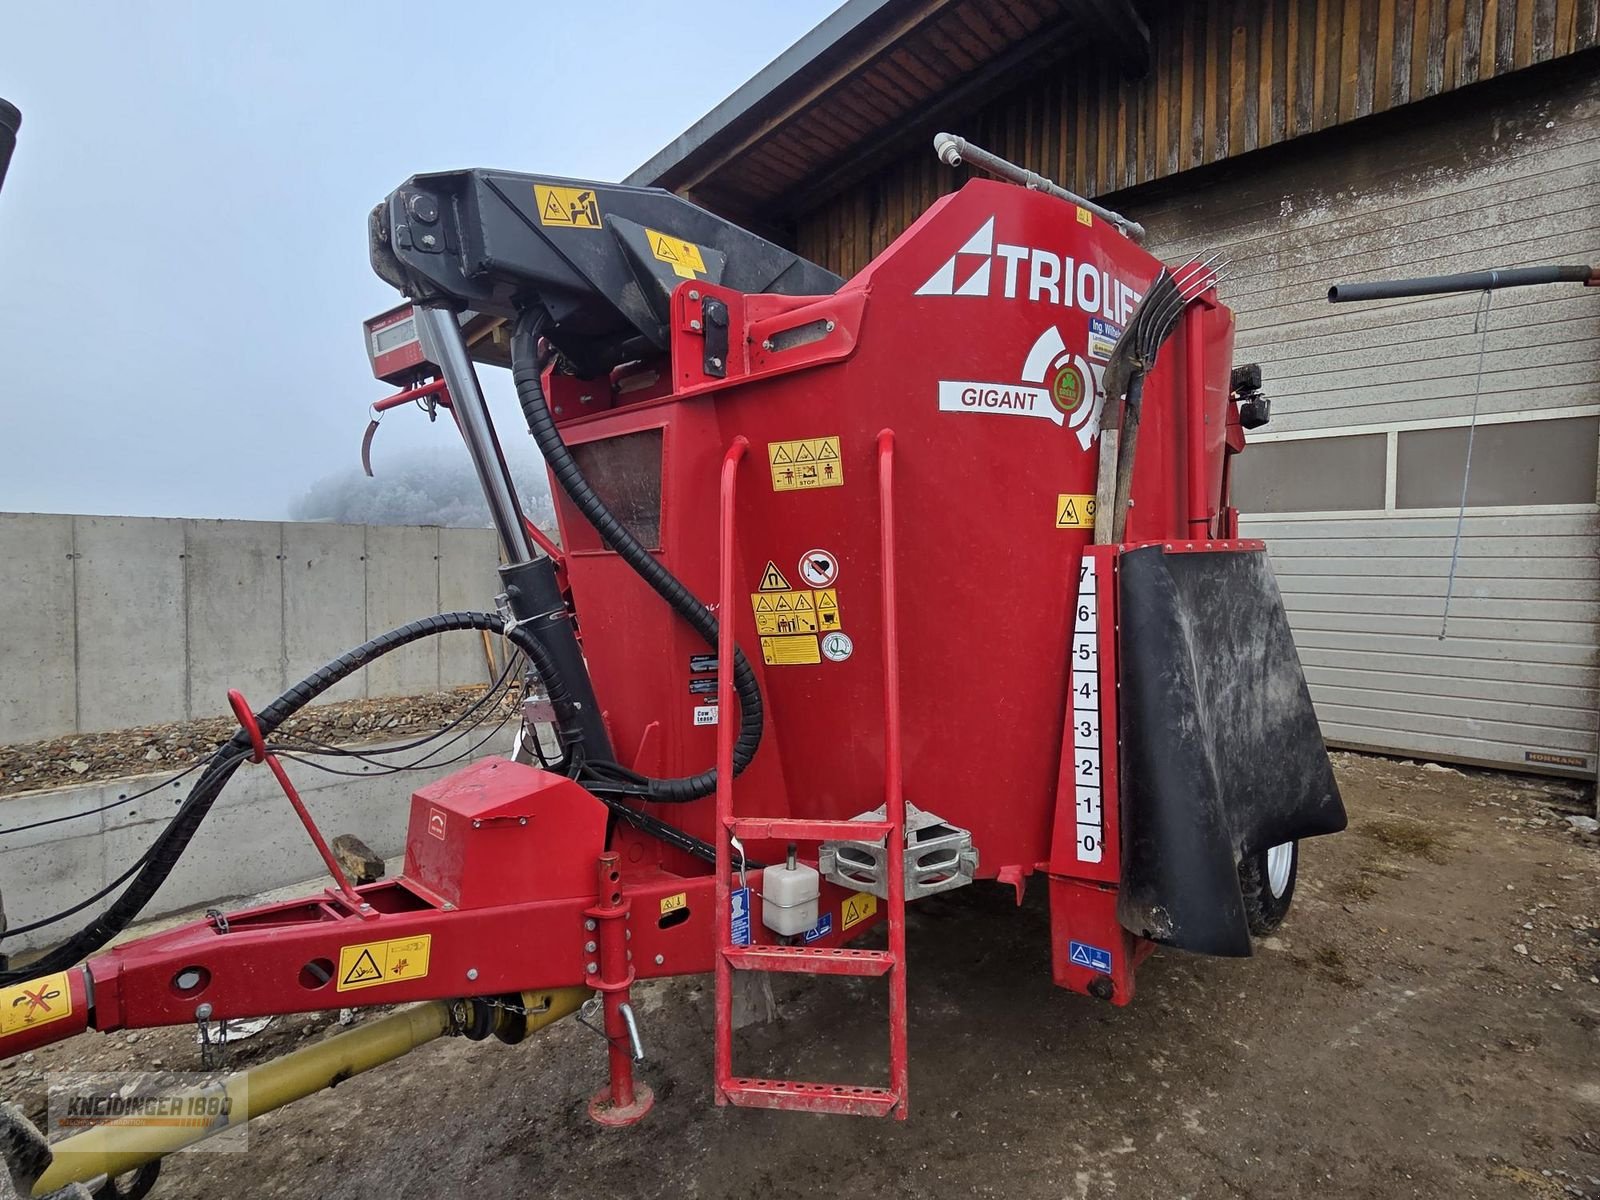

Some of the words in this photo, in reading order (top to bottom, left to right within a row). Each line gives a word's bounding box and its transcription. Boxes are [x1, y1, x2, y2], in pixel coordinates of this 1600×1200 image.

[997, 244, 1142, 327] TRIOLIF
[961, 388, 1038, 411] GIGANT
[1080, 566, 1089, 583] 7
[1078, 605, 1090, 622] 6
[1079, 643, 1090, 660] 5
[1079, 682, 1091, 699] 4
[1080, 721, 1092, 737] 3
[1081, 759, 1093, 776] 2
[1083, 797, 1092, 813] 1
[1083, 835, 1095, 851] 0
